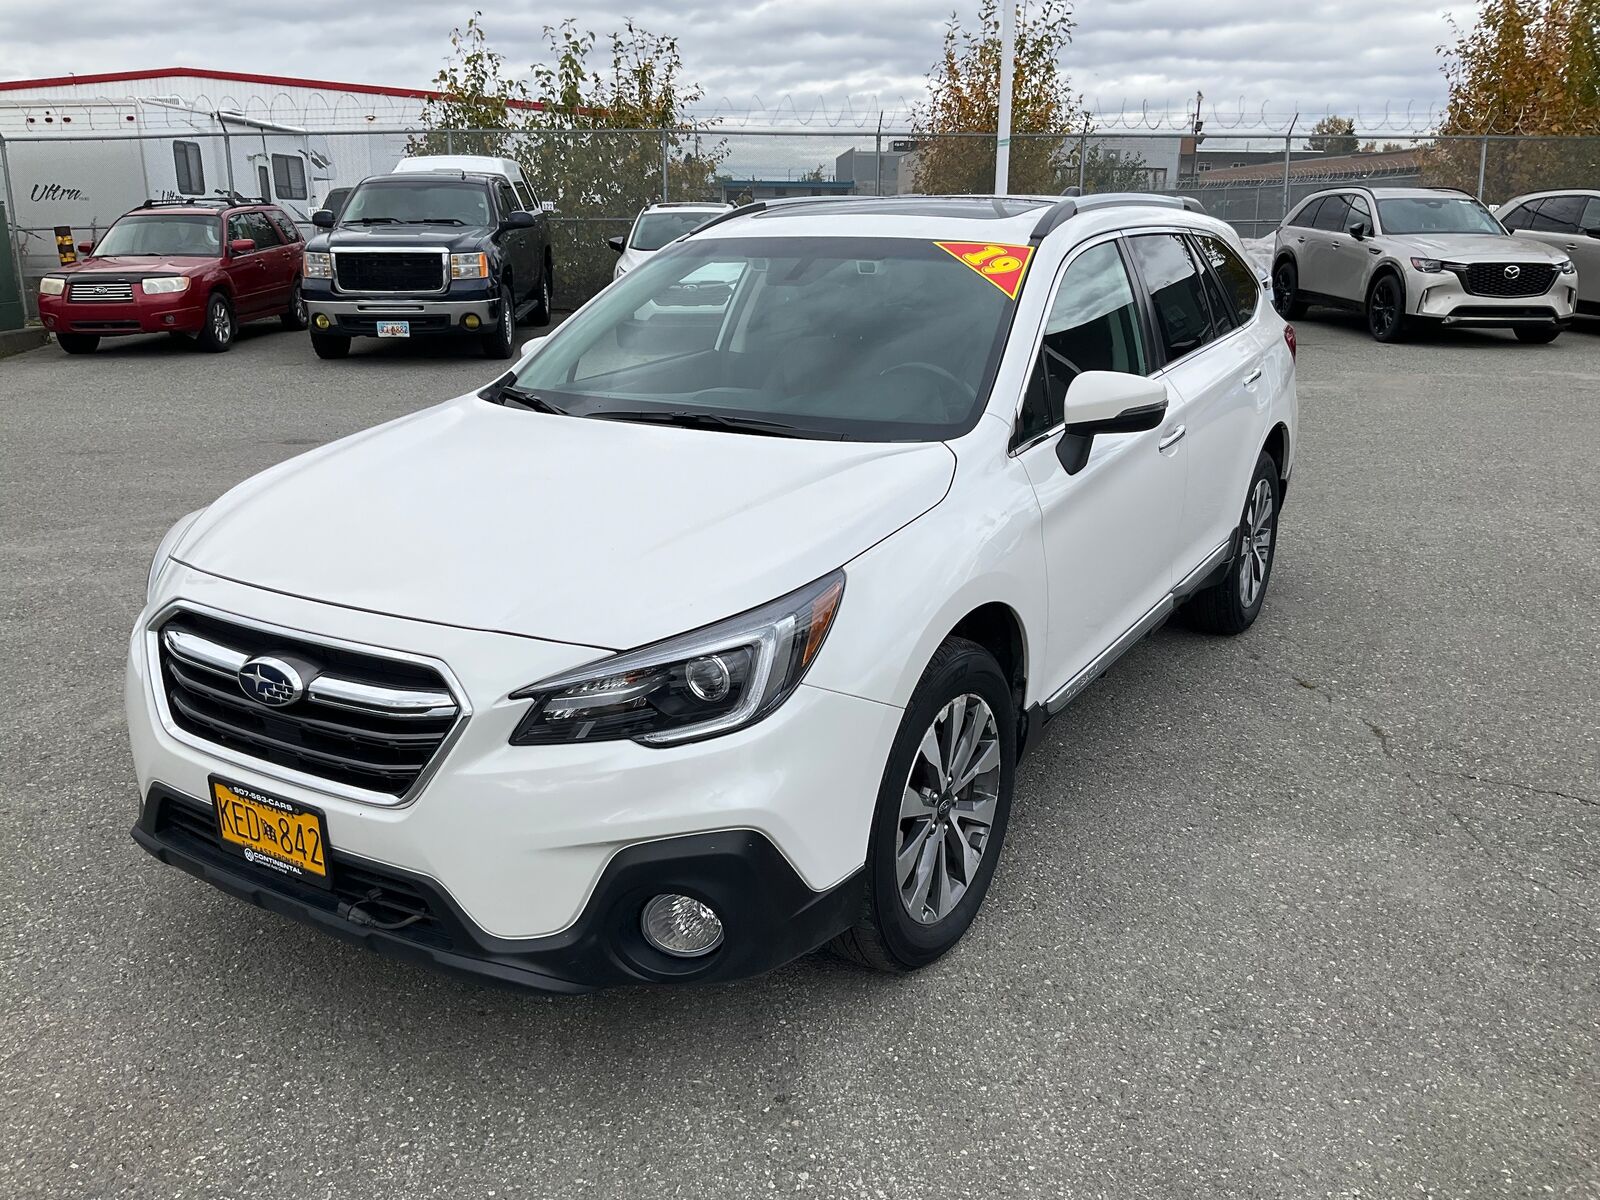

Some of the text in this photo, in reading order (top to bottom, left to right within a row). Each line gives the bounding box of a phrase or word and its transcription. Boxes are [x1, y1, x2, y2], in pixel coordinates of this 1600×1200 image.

[31, 183, 80, 202] Ultra
[962, 245, 1023, 275] 19
[218, 797, 323, 866] KED 842
[253, 852, 303, 875] CONTINENTAL
